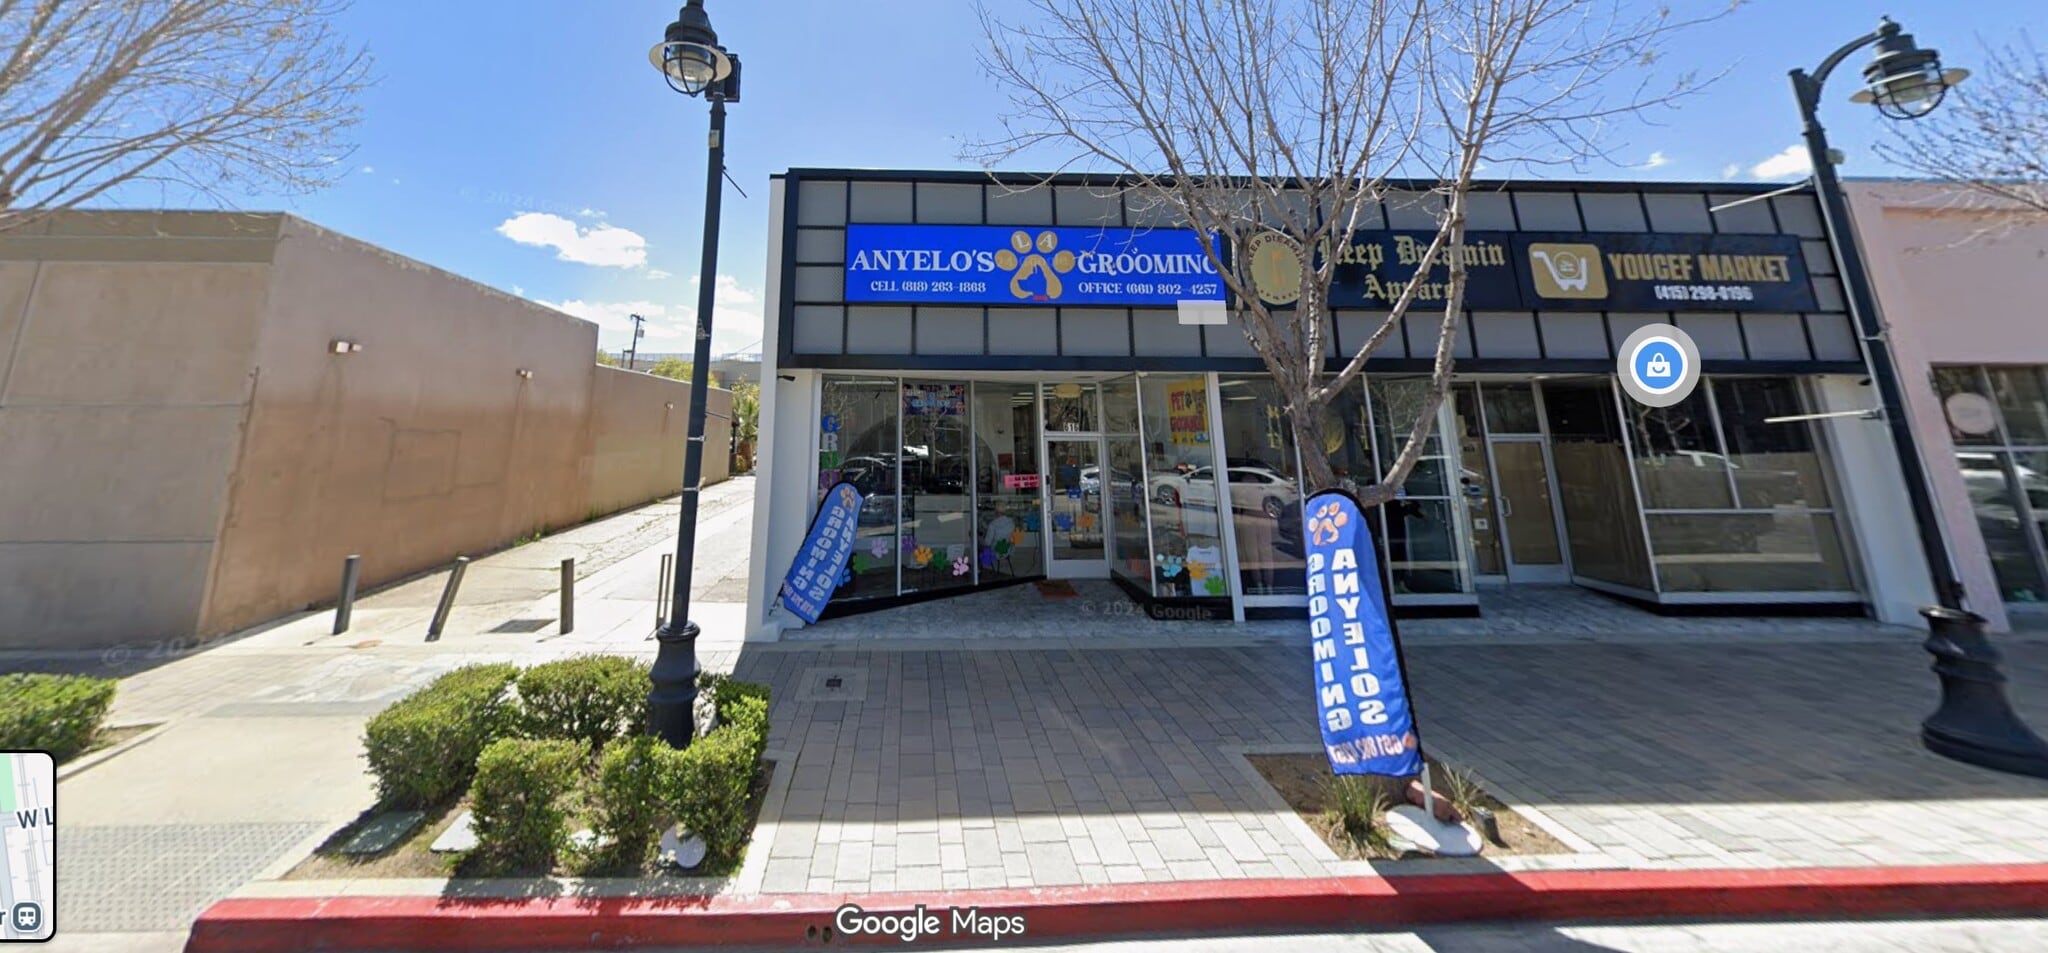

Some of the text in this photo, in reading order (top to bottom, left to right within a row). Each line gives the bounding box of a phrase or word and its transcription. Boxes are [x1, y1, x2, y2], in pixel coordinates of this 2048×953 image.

[850, 249, 996, 272] ANYELO'S
[1697, 254, 1792, 283] MARKET
[870, 280, 899, 292] CELL
[901, 281, 928, 293] (818)
[1078, 282, 1123, 294] OFFICE
[1126, 283, 1154, 295] (661)
